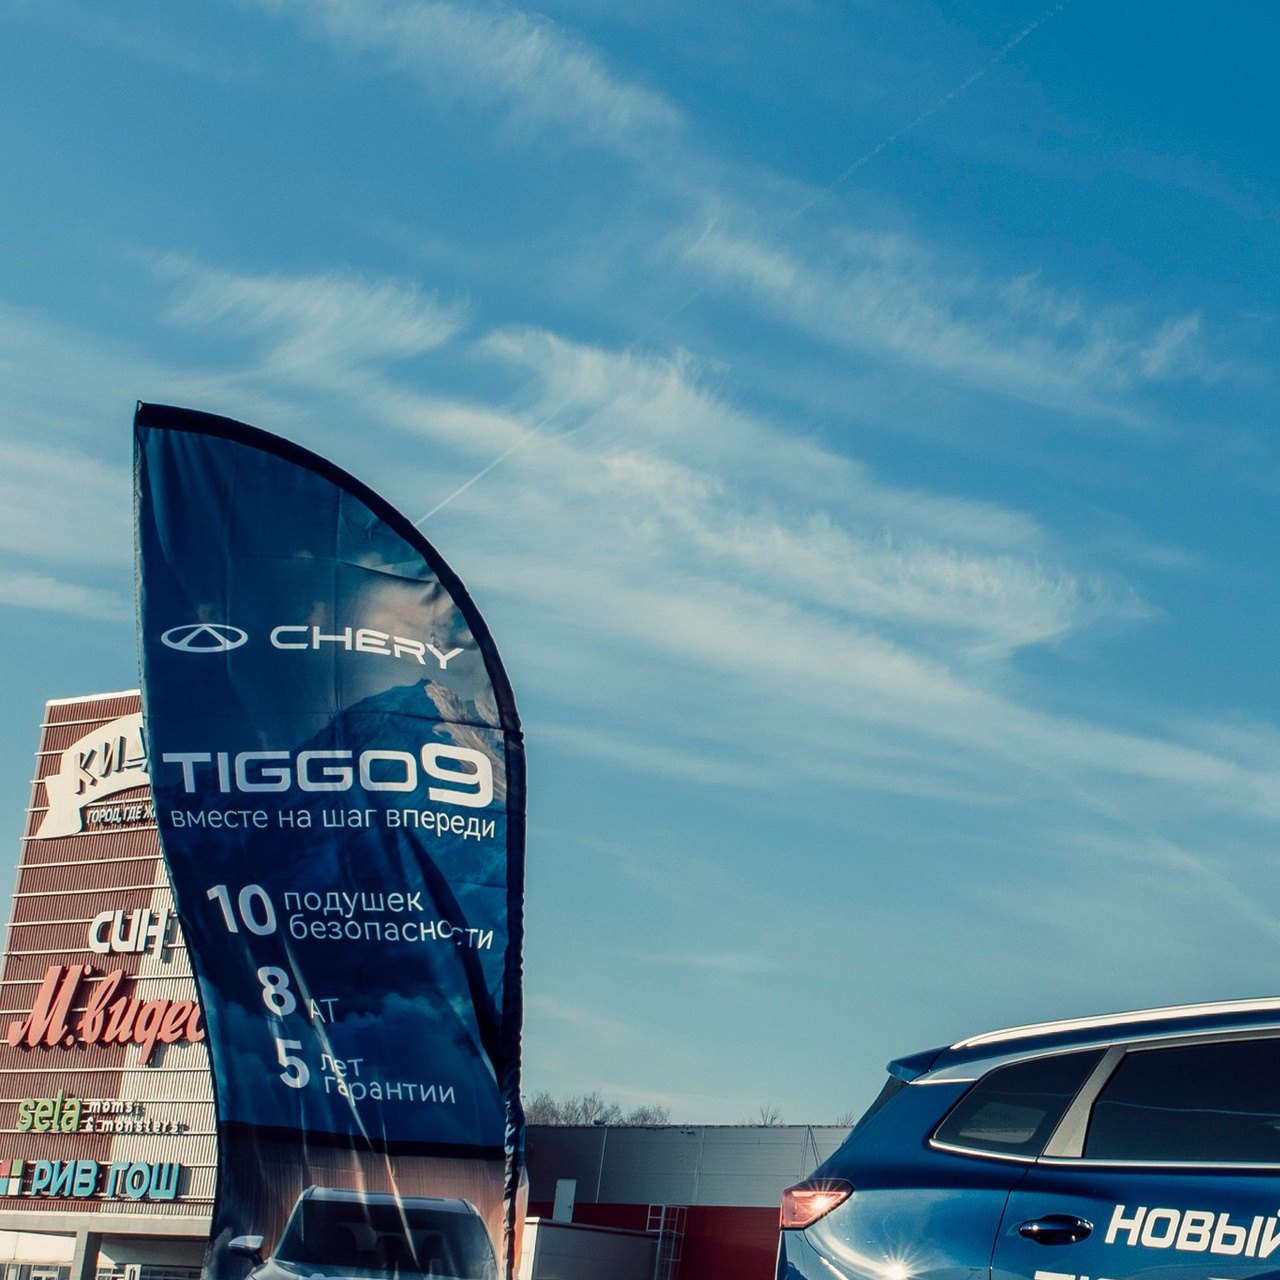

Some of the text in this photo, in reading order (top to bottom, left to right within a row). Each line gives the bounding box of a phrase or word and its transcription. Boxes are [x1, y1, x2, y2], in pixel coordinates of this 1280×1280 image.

[270, 625, 464, 669] CHERY
[162, 743, 494, 808] TIGGO9
[123, 805, 142, 821] ГДЕ
[171, 808, 495, 840] вместе на шаг впереди
[206, 884, 423, 936] 10 подушек
[289, 914, 494, 950] безопасности
[257, 966, 339, 1023] 8 АТ
[275, 1037, 363, 1088] 5 лет
[16, 1090, 133, 1131] sela moms
[324, 1076, 455, 1106] гарантии
[85, 1117, 178, 1132] & monsters
[31, 1159, 180, 1199] РИВ ГОШ
